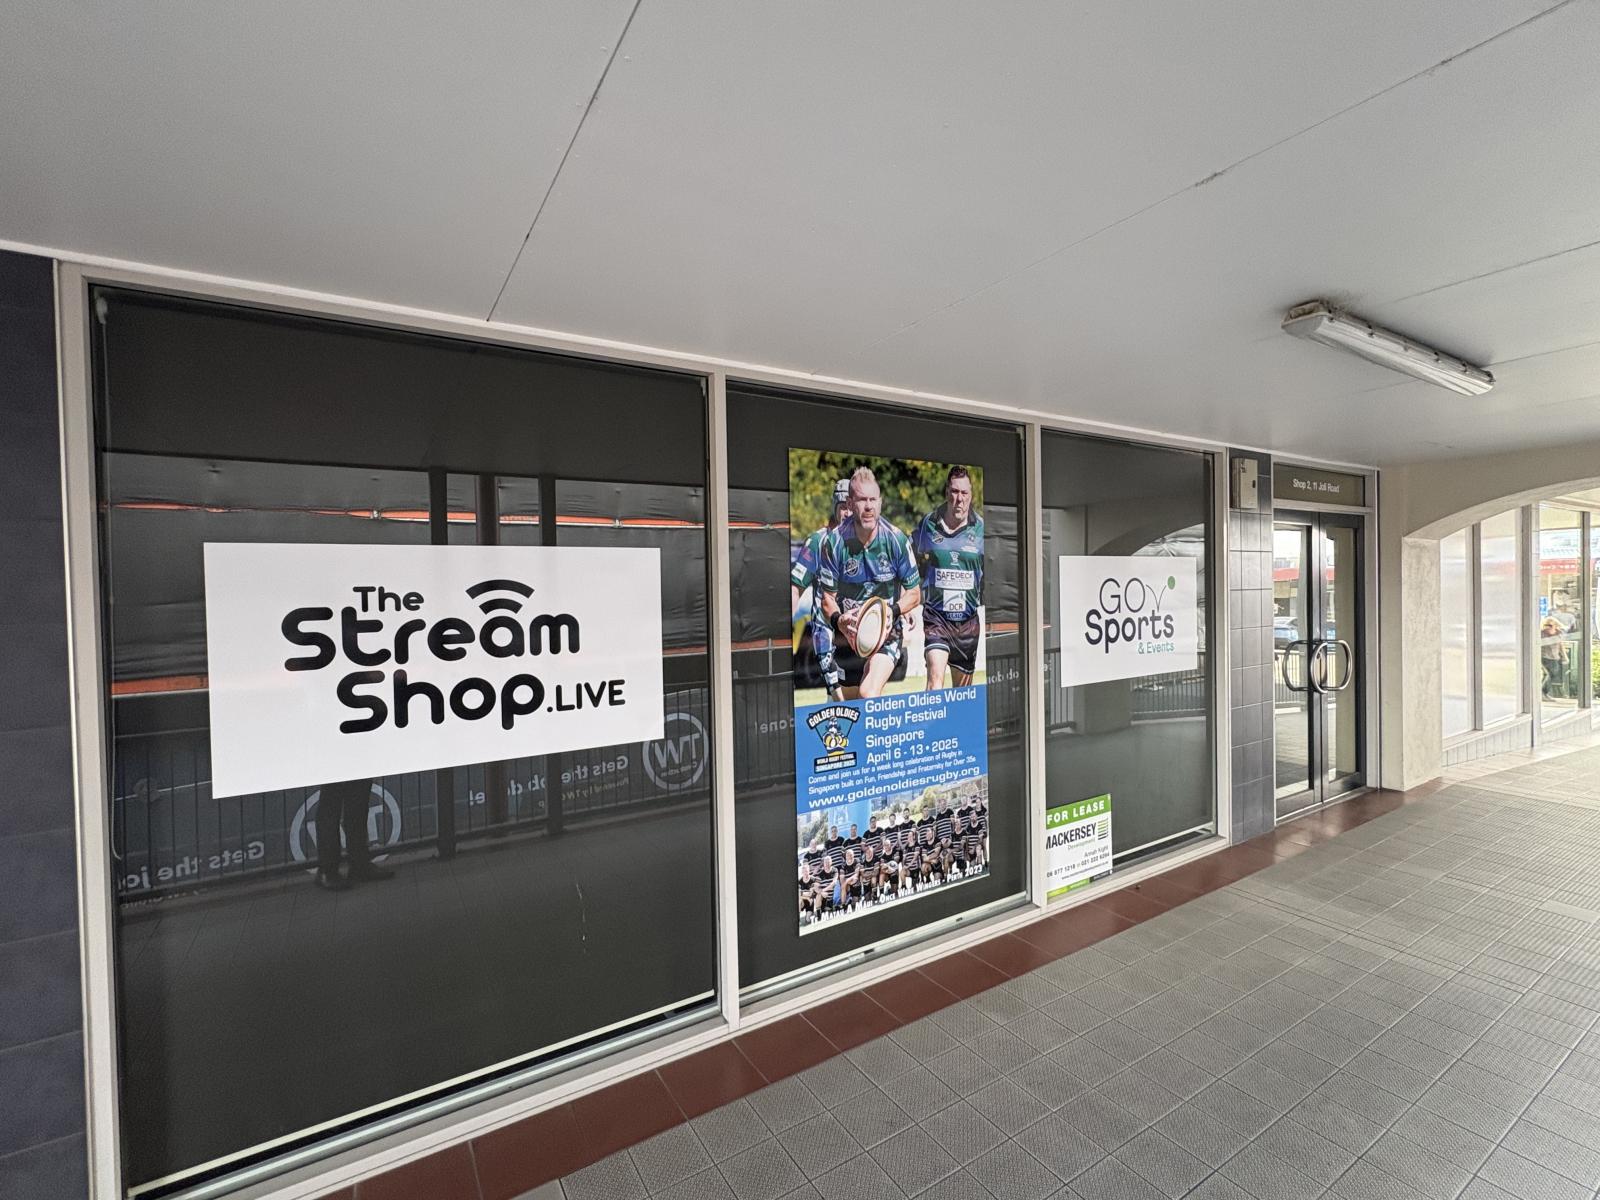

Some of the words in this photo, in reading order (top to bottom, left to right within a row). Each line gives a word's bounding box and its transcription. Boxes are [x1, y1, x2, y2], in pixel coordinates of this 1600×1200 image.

[352, 586, 424, 613] The
[281, 606, 580, 672] Stream
[1085, 608, 1174, 654] Sports
[1138, 642, 1144, 654] &
[1146, 642, 1174, 654] Events
[865, 698, 906, 714] Golden
[908, 691, 942, 707] Oldies
[944, 688, 976, 703] World
[808, 708, 835, 728] GOLDEN
[836, 706, 859, 721] OLDIES
[865, 713, 902, 731] Rugby
[904, 707, 947, 723] Festival
[866, 729, 925, 748] Singapore
[867, 749, 892, 765] April
[894, 748, 902, 758] 6
[910, 744, 924, 756] 13
[932, 738, 958, 752] 2025
[808, 775, 826, 784] Come
[841, 771, 852, 779] join
[877, 763, 892, 771] week
[892, 760, 904, 768] long
[905, 755, 934, 766] celebration
[942, 751, 958, 760] Rugby
[808, 784, 840, 796] Singapore
[842, 780, 854, 788] built
[878, 770, 906, 781] Friendship
[918, 762, 944, 773] Fraternity
[954, 758, 966, 766] Over
[808, 766, 980, 809] www.goldenoldiesrugby.org
[1046, 810, 1068, 825] FOR
[1072, 800, 1105, 818] LEASE
